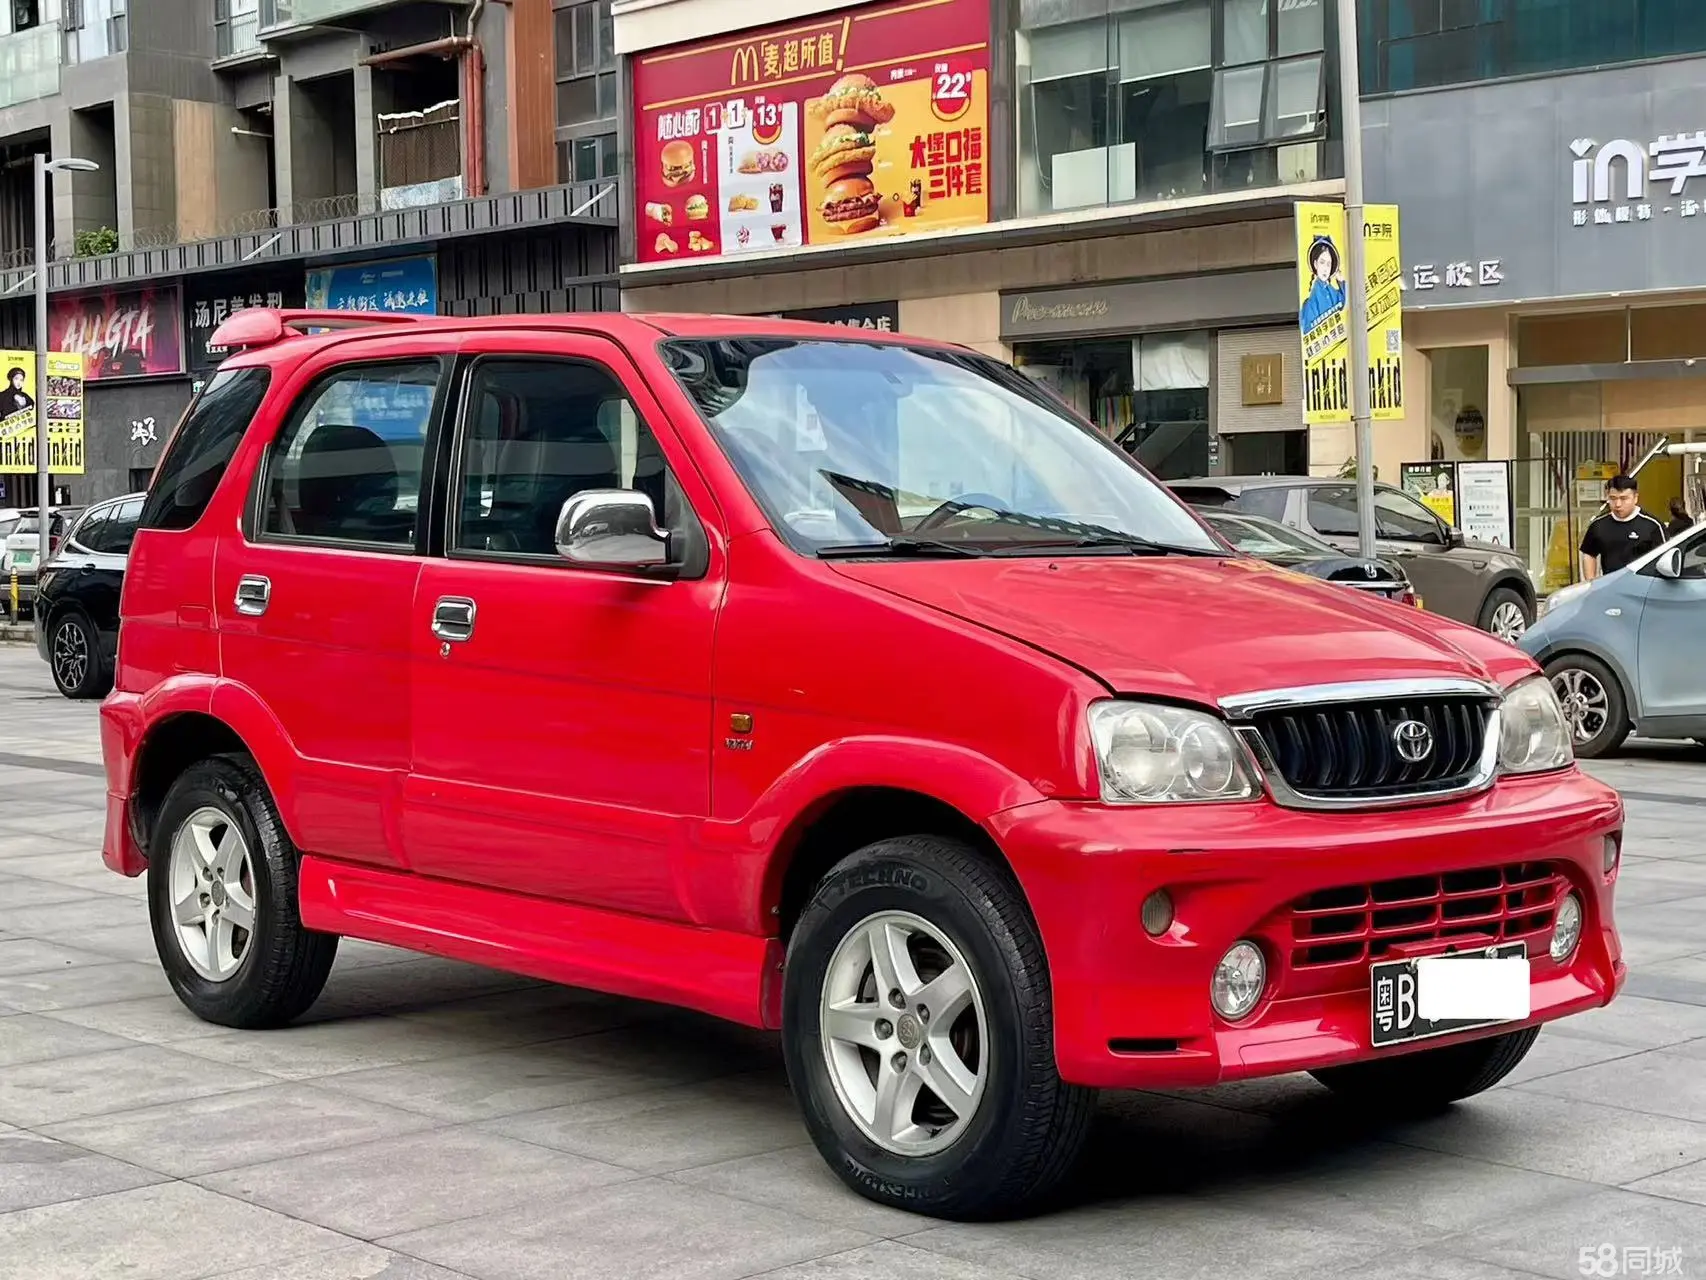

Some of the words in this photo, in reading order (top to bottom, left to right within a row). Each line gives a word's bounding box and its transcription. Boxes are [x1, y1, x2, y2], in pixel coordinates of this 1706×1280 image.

[657, 108, 701, 141] 随心配
[909, 127, 982, 169] 大堡口福
[928, 163, 982, 199] 三件套
[1400, 259, 1502, 290] 运校区
[1304, 358, 1348, 412] inkid
